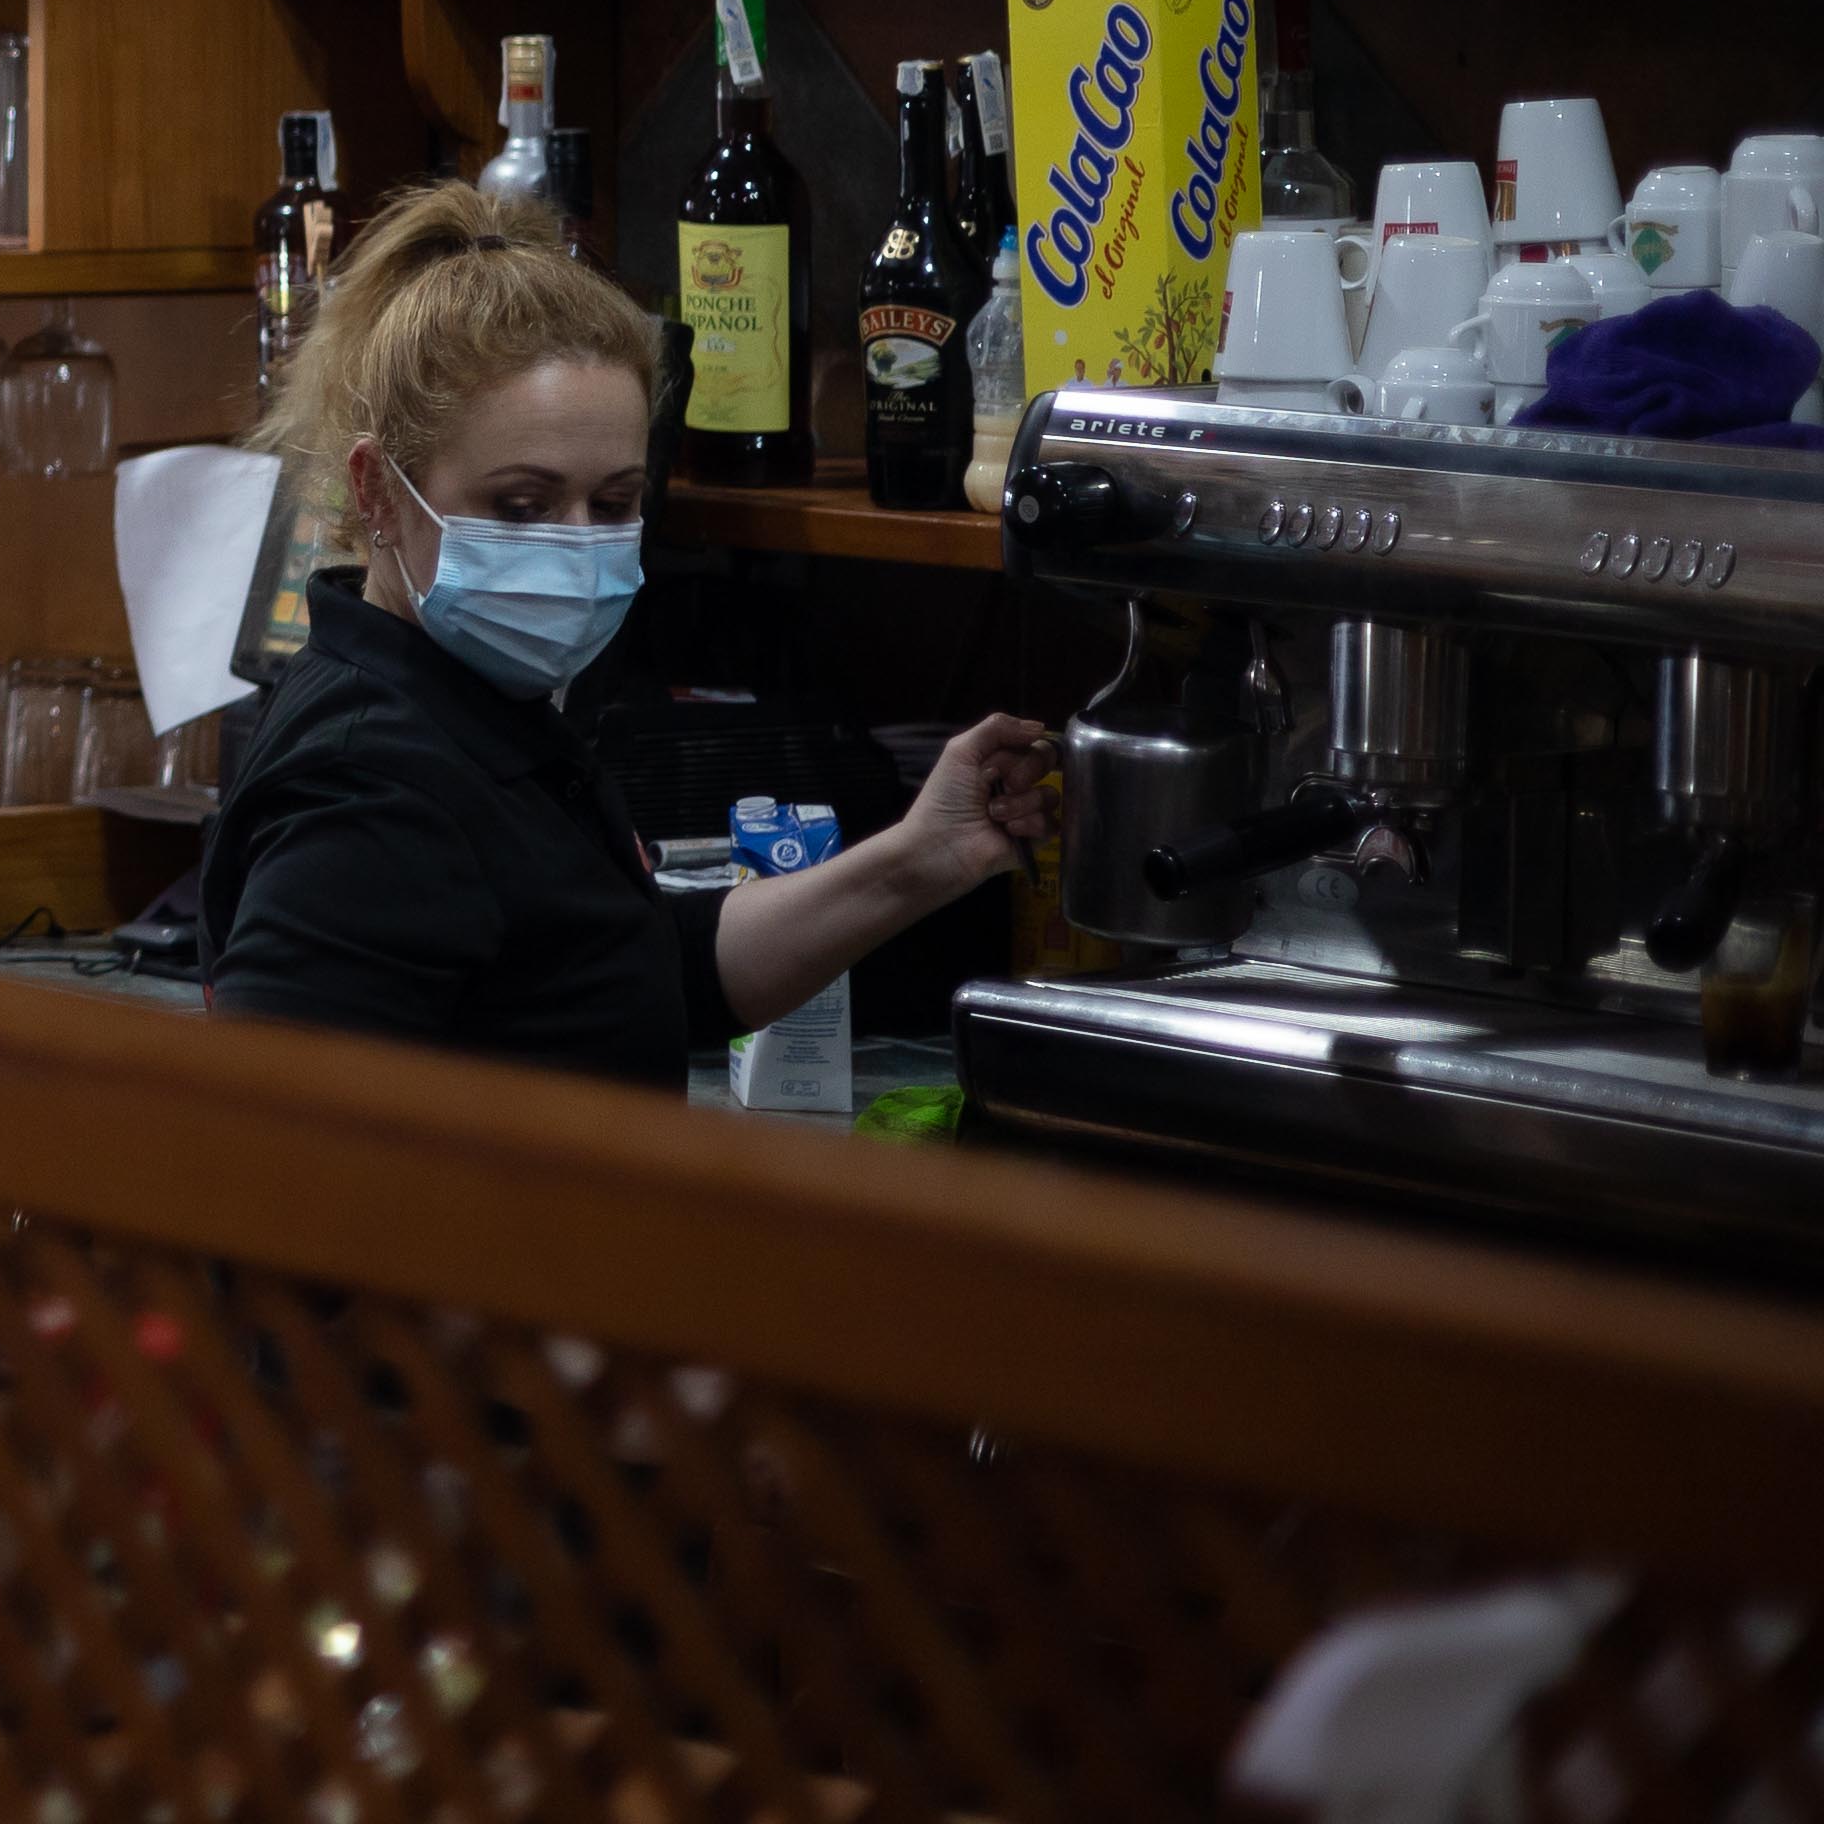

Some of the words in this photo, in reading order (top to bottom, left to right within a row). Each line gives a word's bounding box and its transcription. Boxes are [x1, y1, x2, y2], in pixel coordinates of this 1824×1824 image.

[1025, 0, 1152, 309] ColaCao
[1221, 120, 1250, 224] Original
[1103, 156, 1145, 270] Original
[686, 295, 756, 313] PONCHE
[861, 309, 950, 341] BAILEYS
[1070, 417, 1166, 439] ariete
